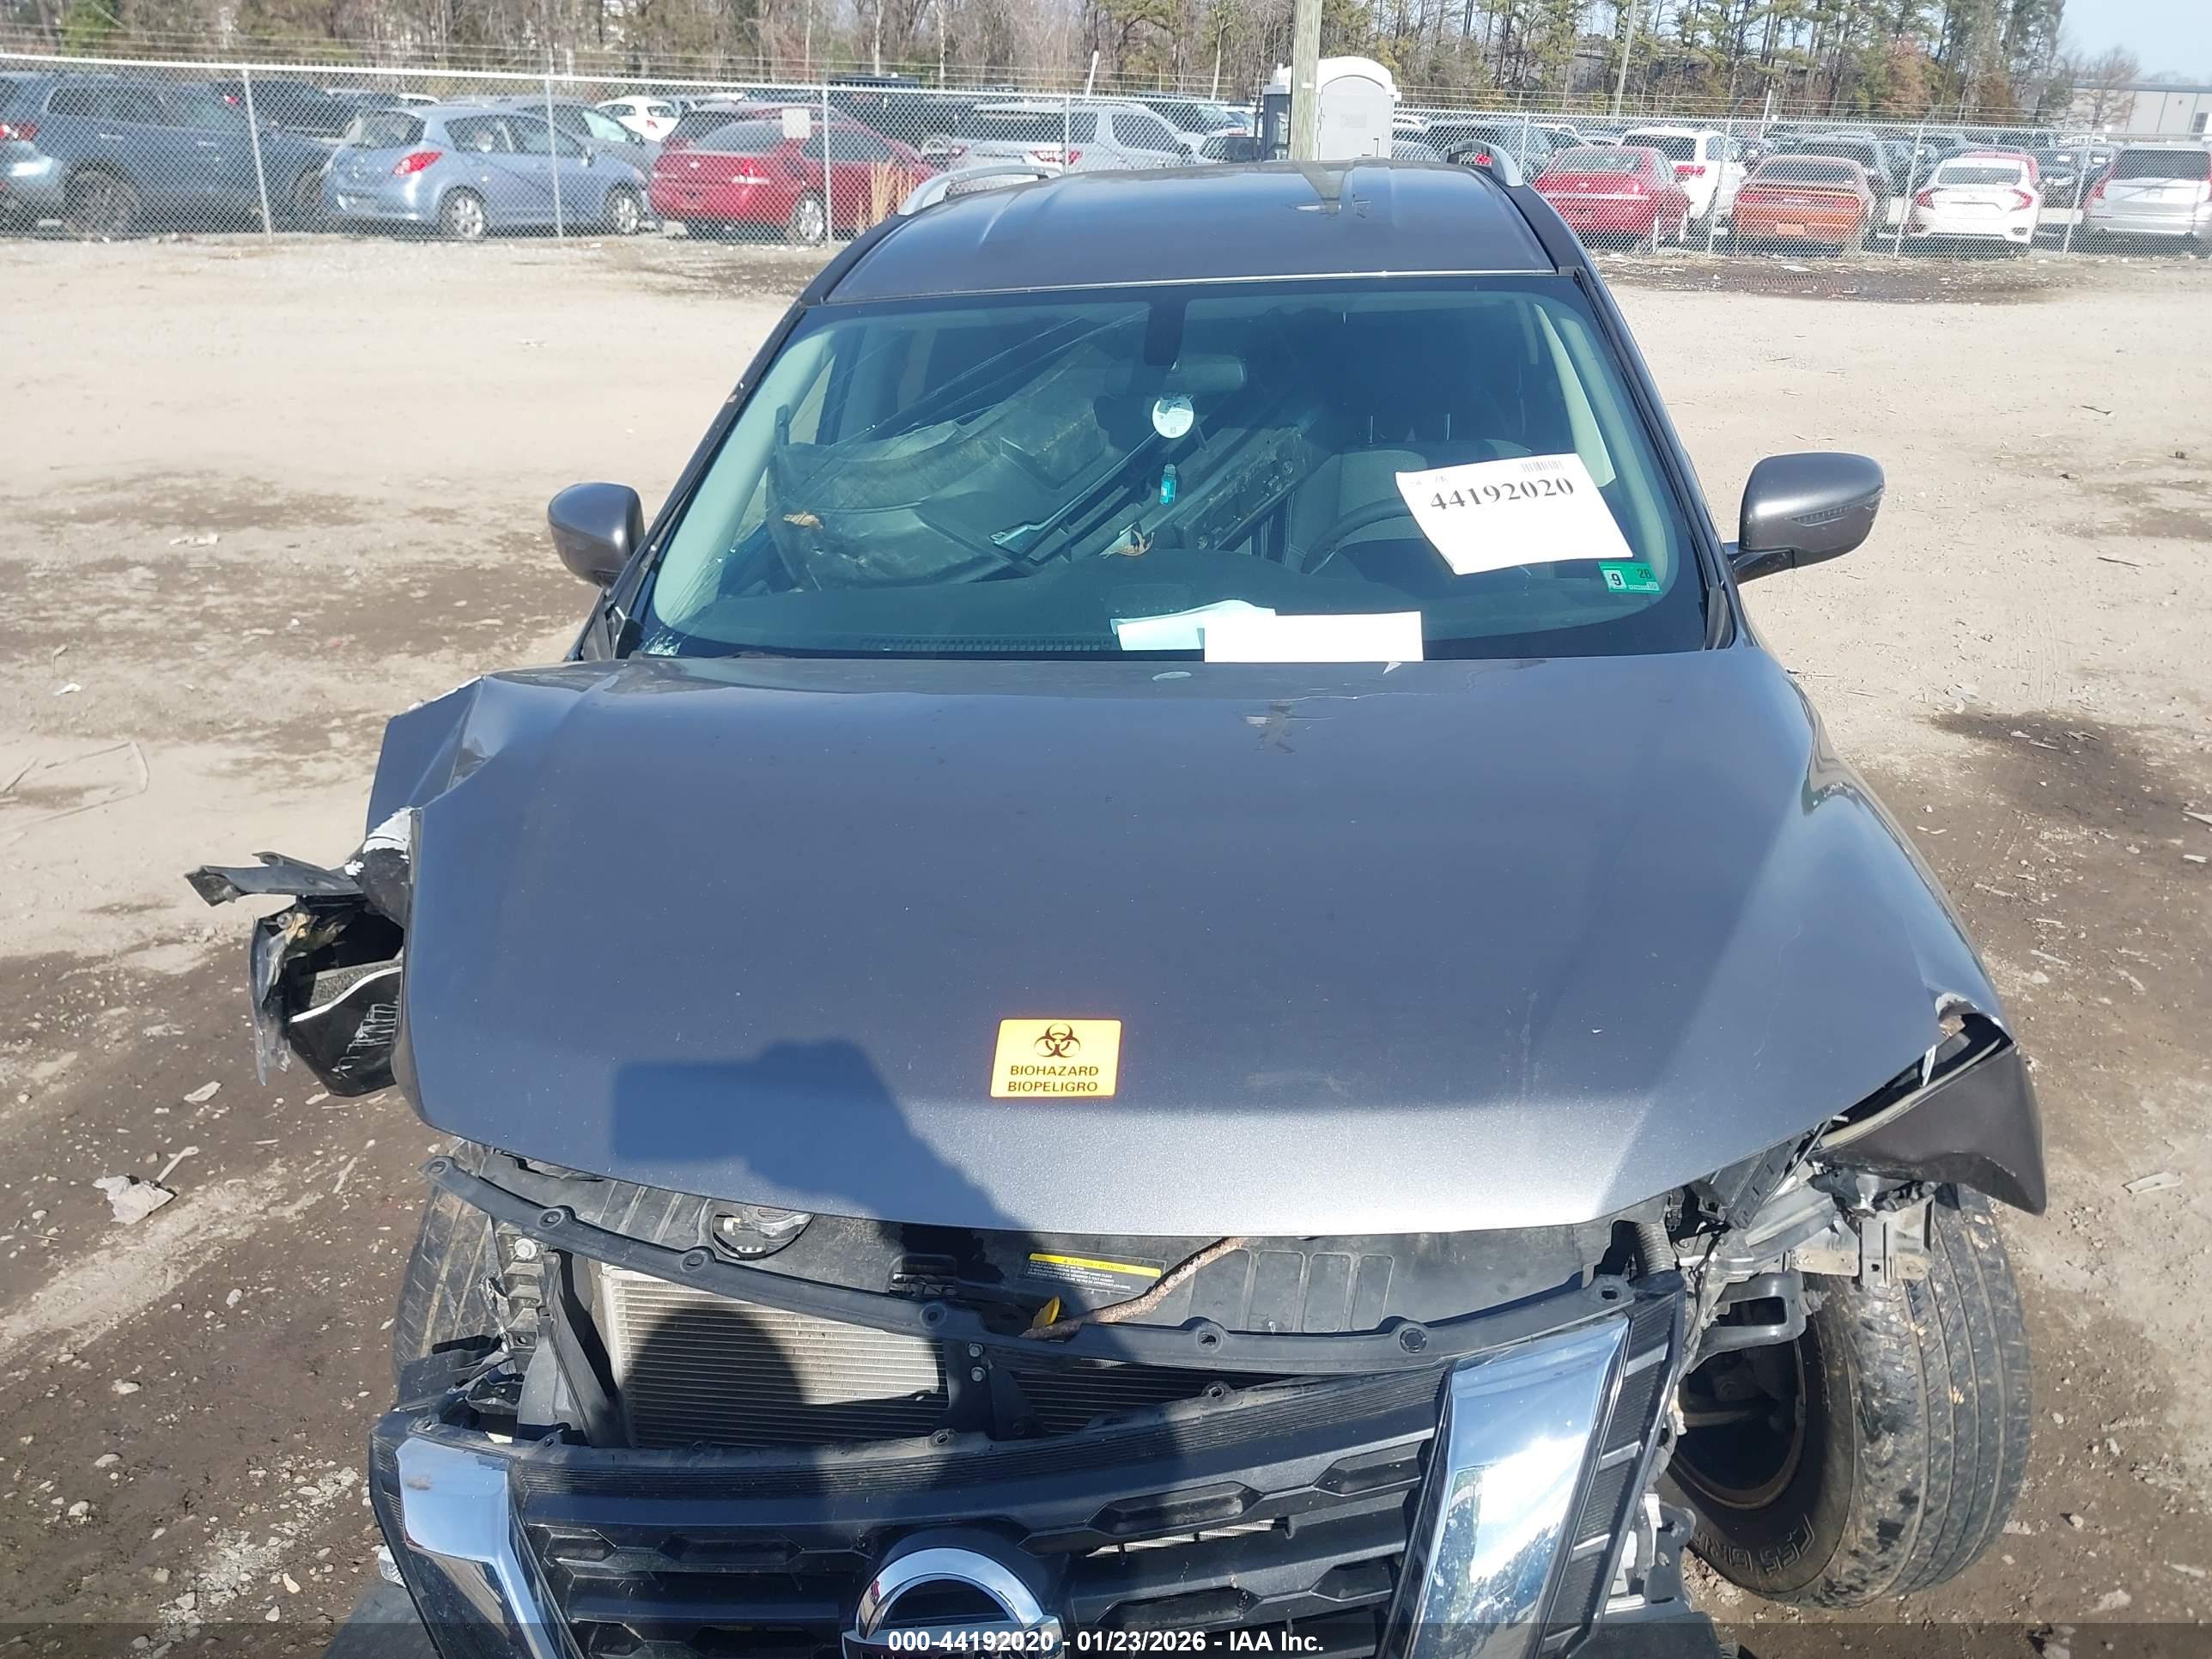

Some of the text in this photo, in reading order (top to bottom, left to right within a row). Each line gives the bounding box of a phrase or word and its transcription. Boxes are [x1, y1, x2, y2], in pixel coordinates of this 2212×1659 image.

[1431, 477, 1574, 510] 44192020
[1611, 573, 1622, 586] 9
[1010, 1066, 1099, 1077] BIOHAZARD
[1007, 1081, 1098, 1092] BIOPELIGRO
